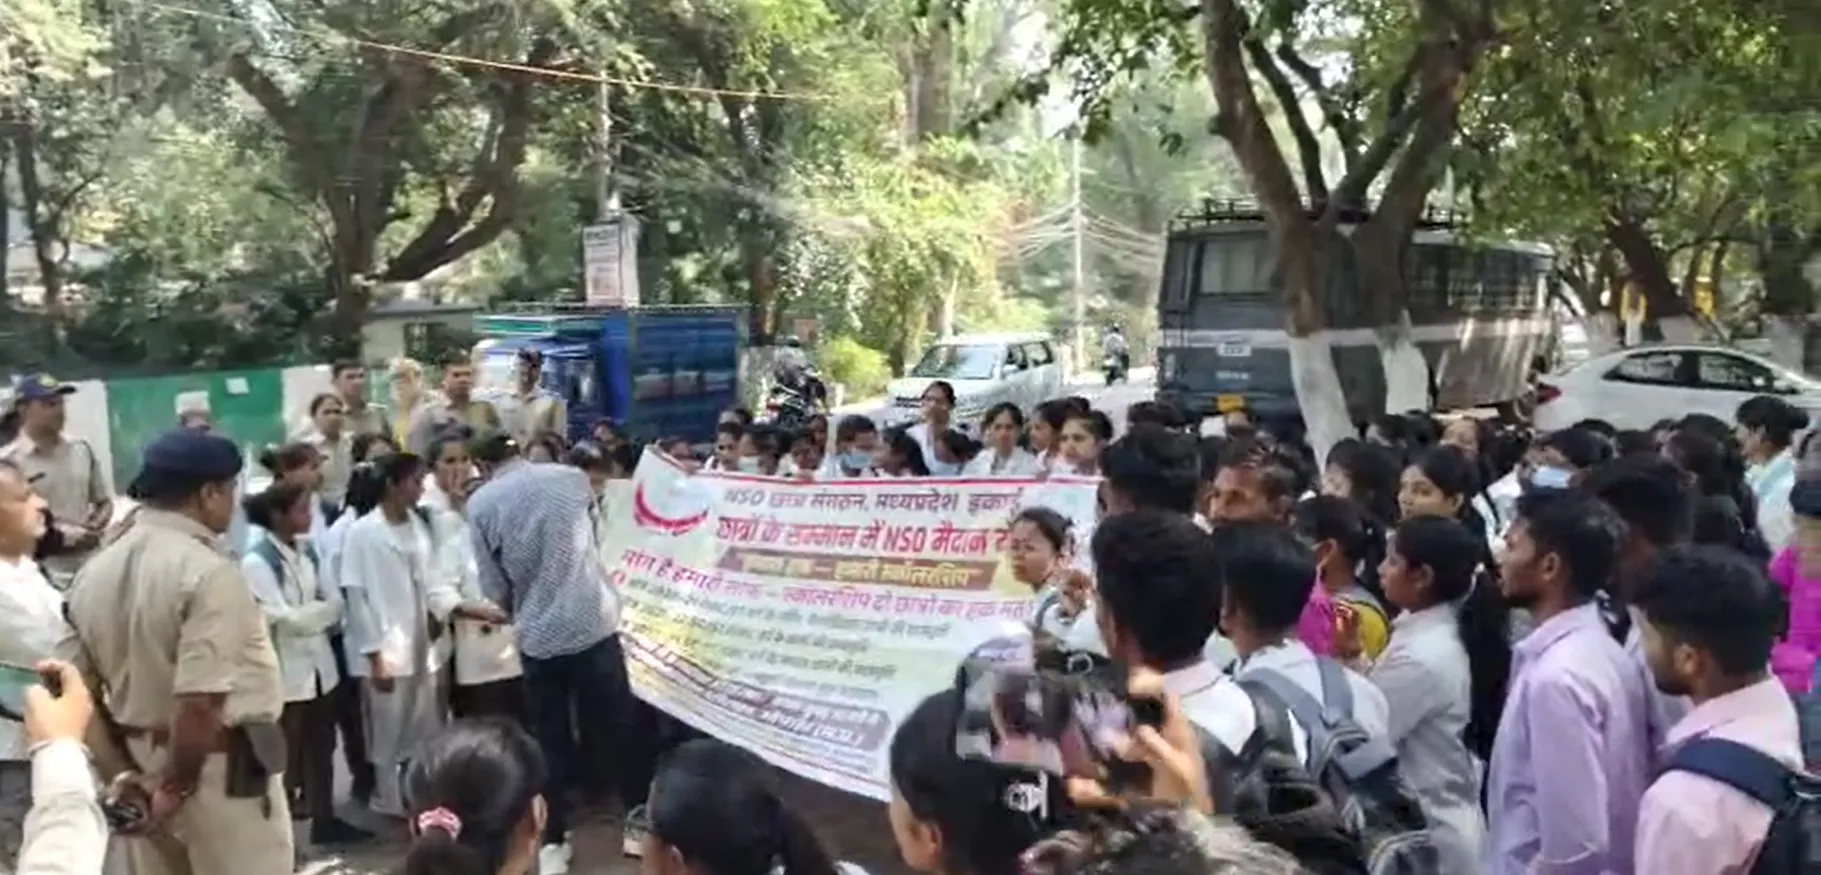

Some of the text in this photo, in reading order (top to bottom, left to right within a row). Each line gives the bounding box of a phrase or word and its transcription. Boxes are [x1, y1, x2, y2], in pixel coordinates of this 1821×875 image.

[724, 487, 765, 506] NSO
[875, 488, 959, 513] मध्यप्रदेश
[883, 525, 927, 552] NSO
[930, 521, 989, 555] मैदान
